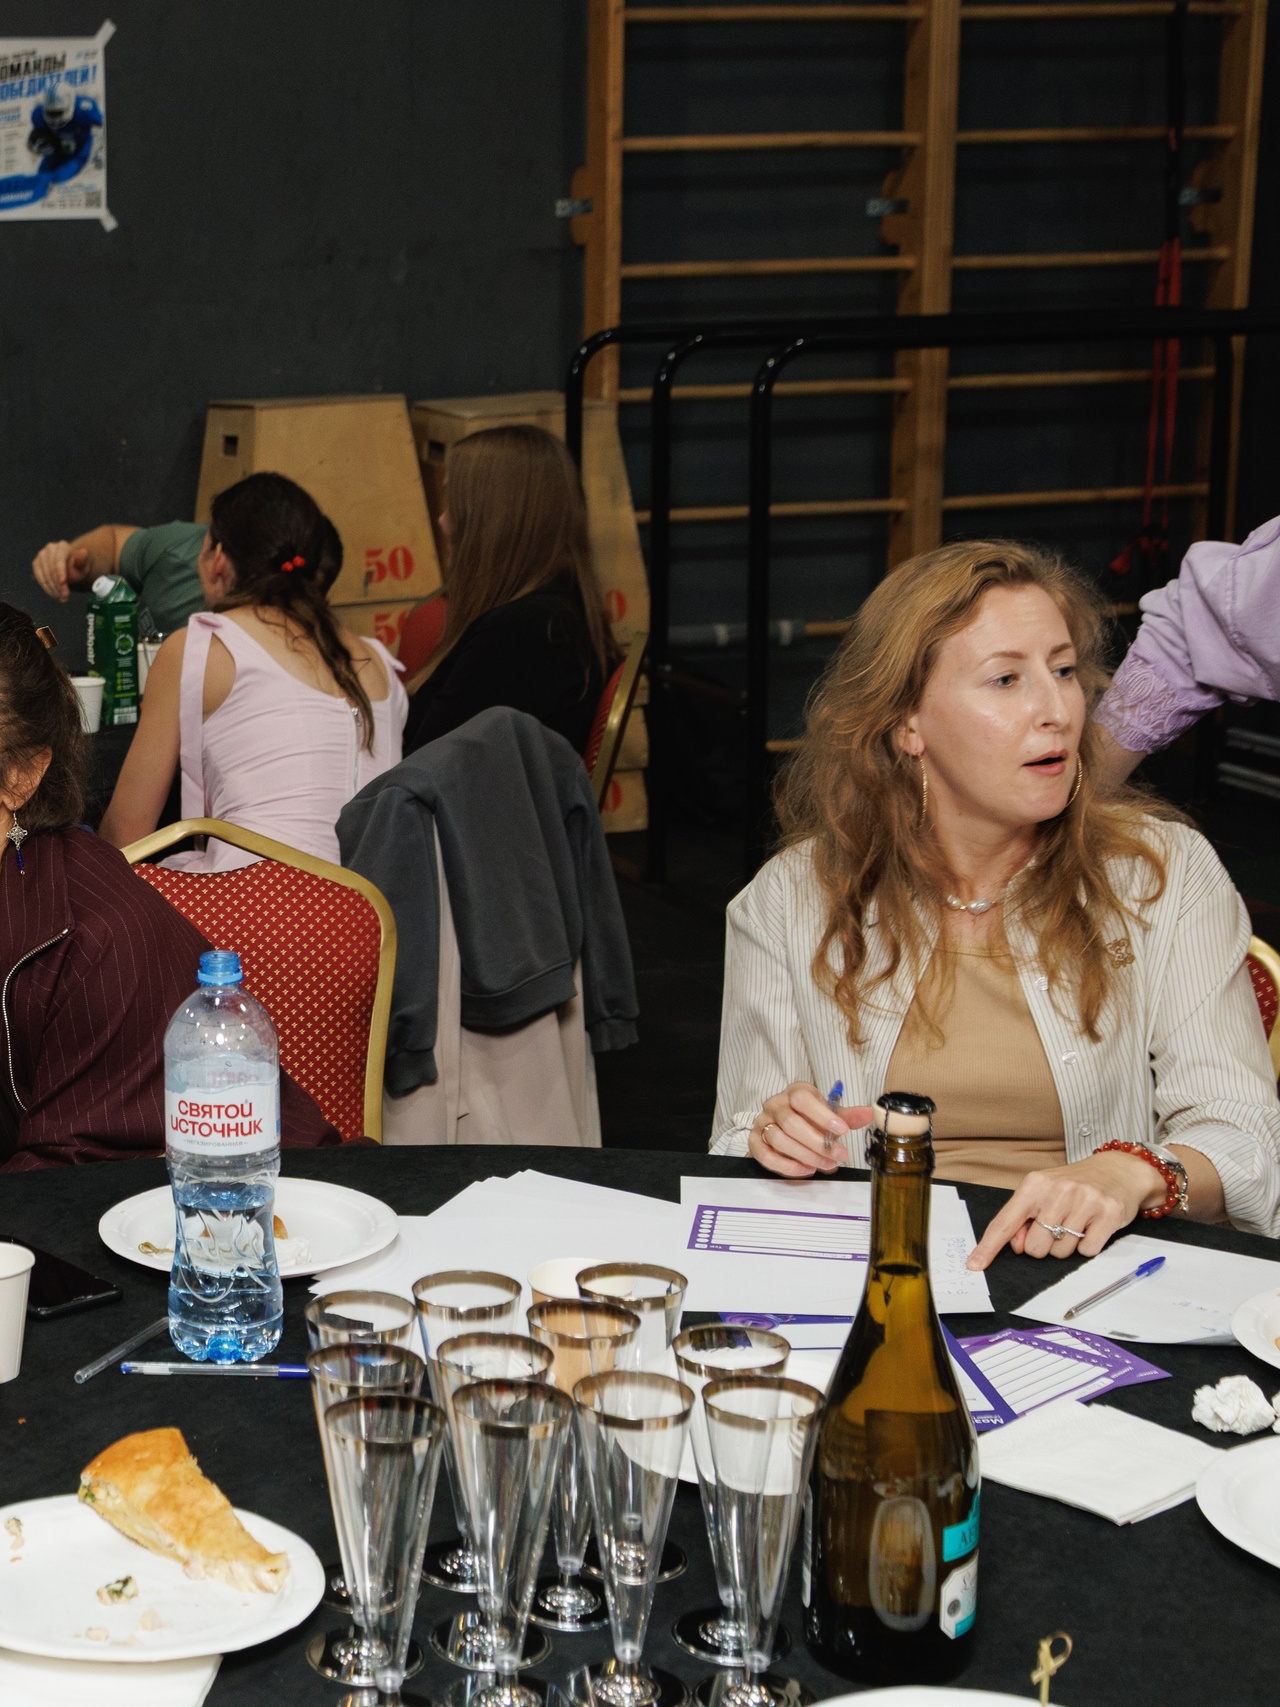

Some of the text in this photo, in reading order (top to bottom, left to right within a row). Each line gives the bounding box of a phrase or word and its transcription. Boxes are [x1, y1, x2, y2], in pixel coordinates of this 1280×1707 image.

[365, 546, 414, 584] 50
[178, 1099, 252, 1119] СВЯТОЙ
[170, 1114, 263, 1138] ИСТОЧНИК
